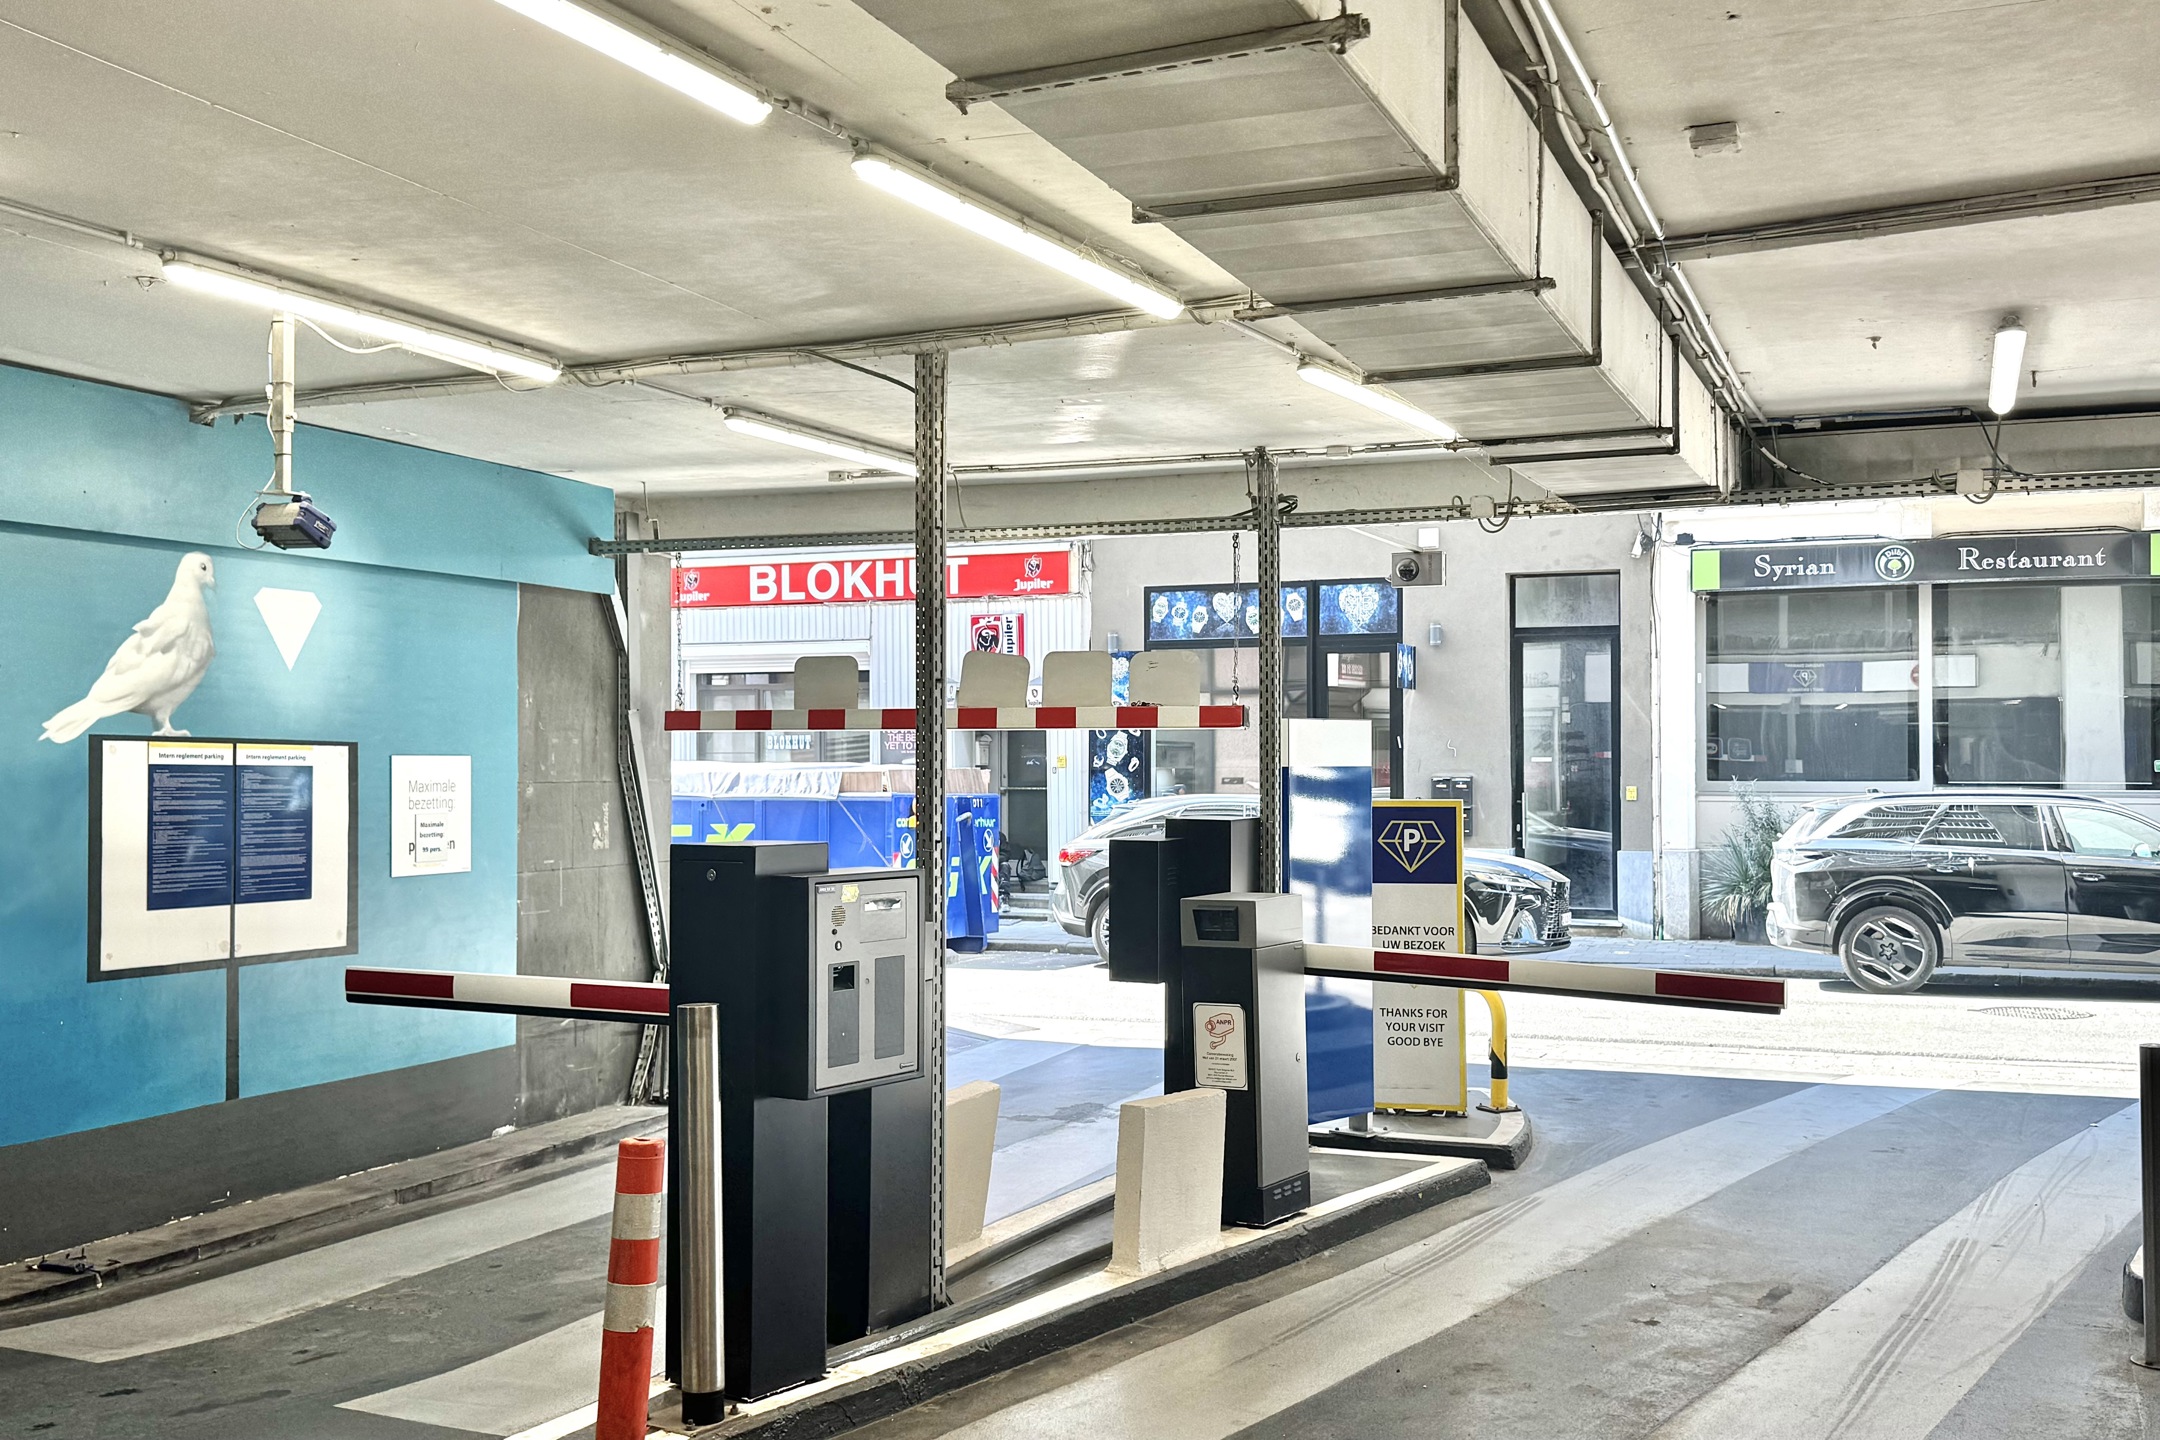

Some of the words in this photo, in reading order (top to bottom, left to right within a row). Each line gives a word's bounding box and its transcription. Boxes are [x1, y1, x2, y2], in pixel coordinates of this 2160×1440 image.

[1957, 547, 2106, 570] Restaurant
[1754, 554, 1836, 582] Syrian
[749, 557, 968, 601] BLOKHT
[1013, 578, 1054, 592] Jupiler
[1004, 616, 1016, 653] upiler
[766, 735, 812, 750] BLOKHUT
[888, 733, 904, 741] THE
[884, 741, 900, 750] YET
[408, 779, 456, 793] Maximale
[1403, 828, 1421, 851] P
[1372, 926, 1421, 936] BEDANKT
[1423, 926, 1455, 936] VOOR
[1382, 940, 1401, 950] UW
[1404, 941, 1446, 950] BEZOEK
[1379, 1008, 1424, 1018] THANKS
[1427, 1009, 1448, 1019] FOR
[1386, 1022, 1416, 1032] YOUR
[1418, 1023, 1445, 1033] VISIT
[1387, 1036, 1421, 1047] GOOD
[1424, 1037, 1444, 1047] BYE
